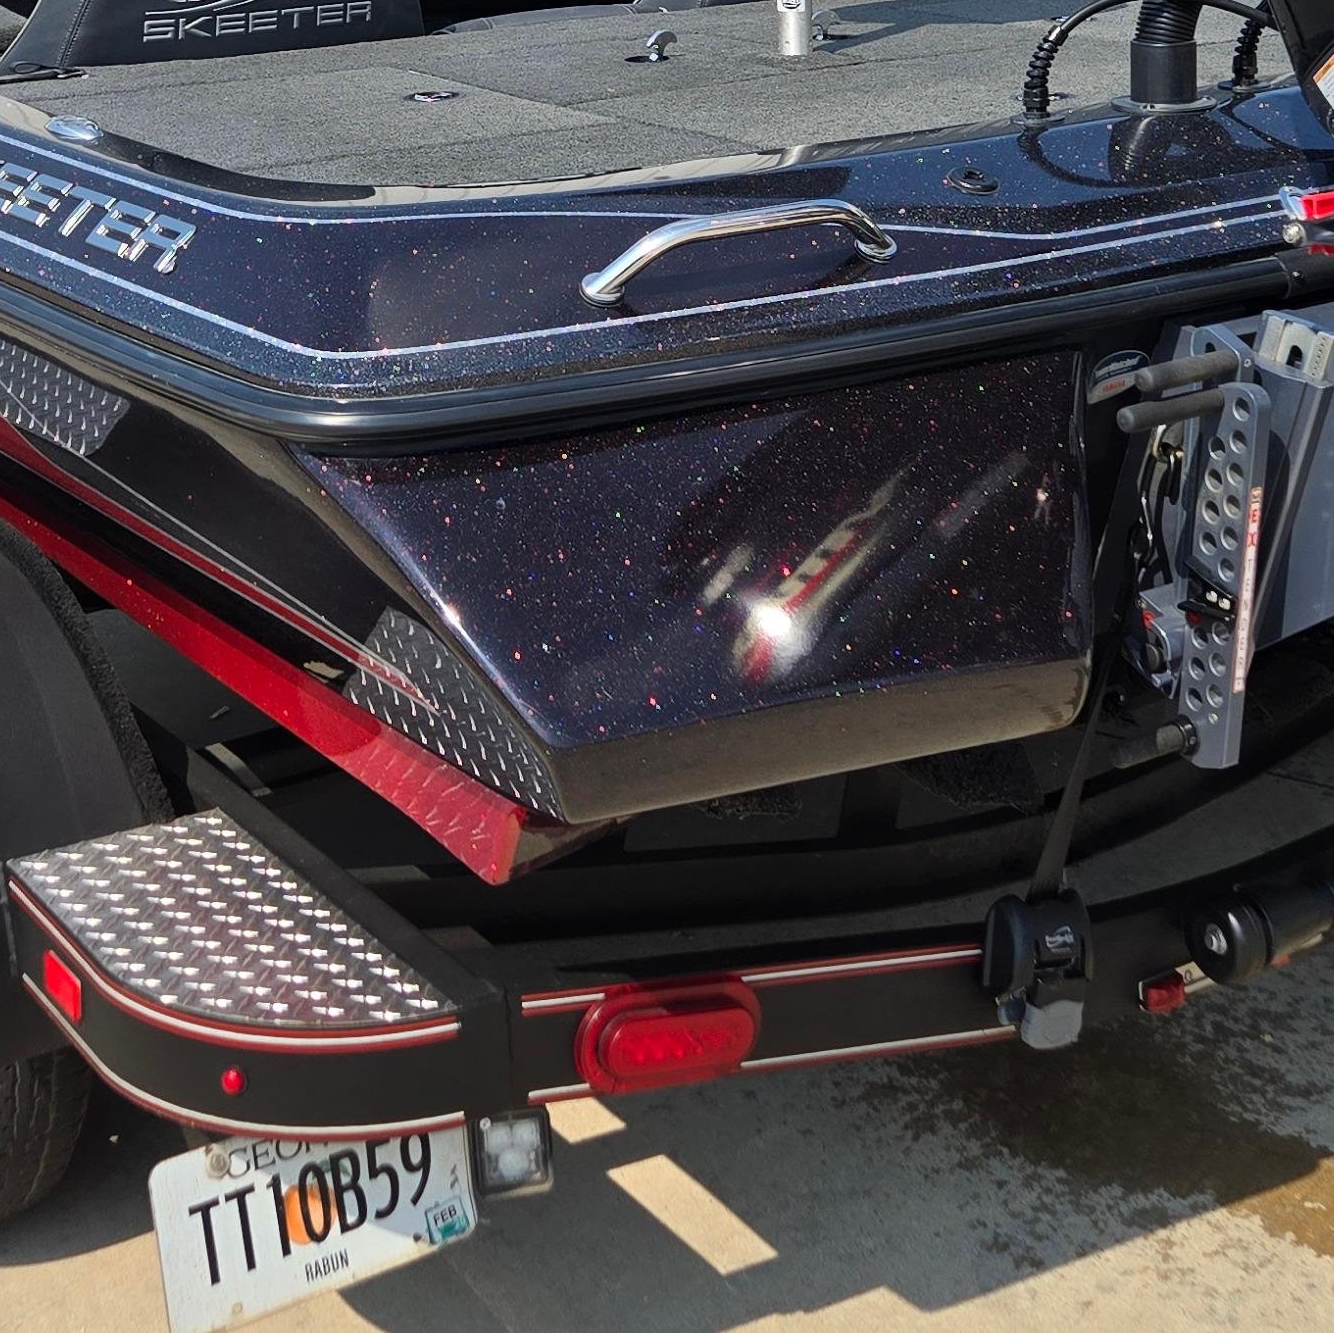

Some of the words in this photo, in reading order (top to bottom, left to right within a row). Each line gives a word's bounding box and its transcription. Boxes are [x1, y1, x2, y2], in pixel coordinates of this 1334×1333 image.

[142, 0, 372, 42] SKEETER
[188, 1132, 432, 1287] TT10B59
[433, 1204, 457, 1226] FEB
[304, 1249, 350, 1283] RABUN
